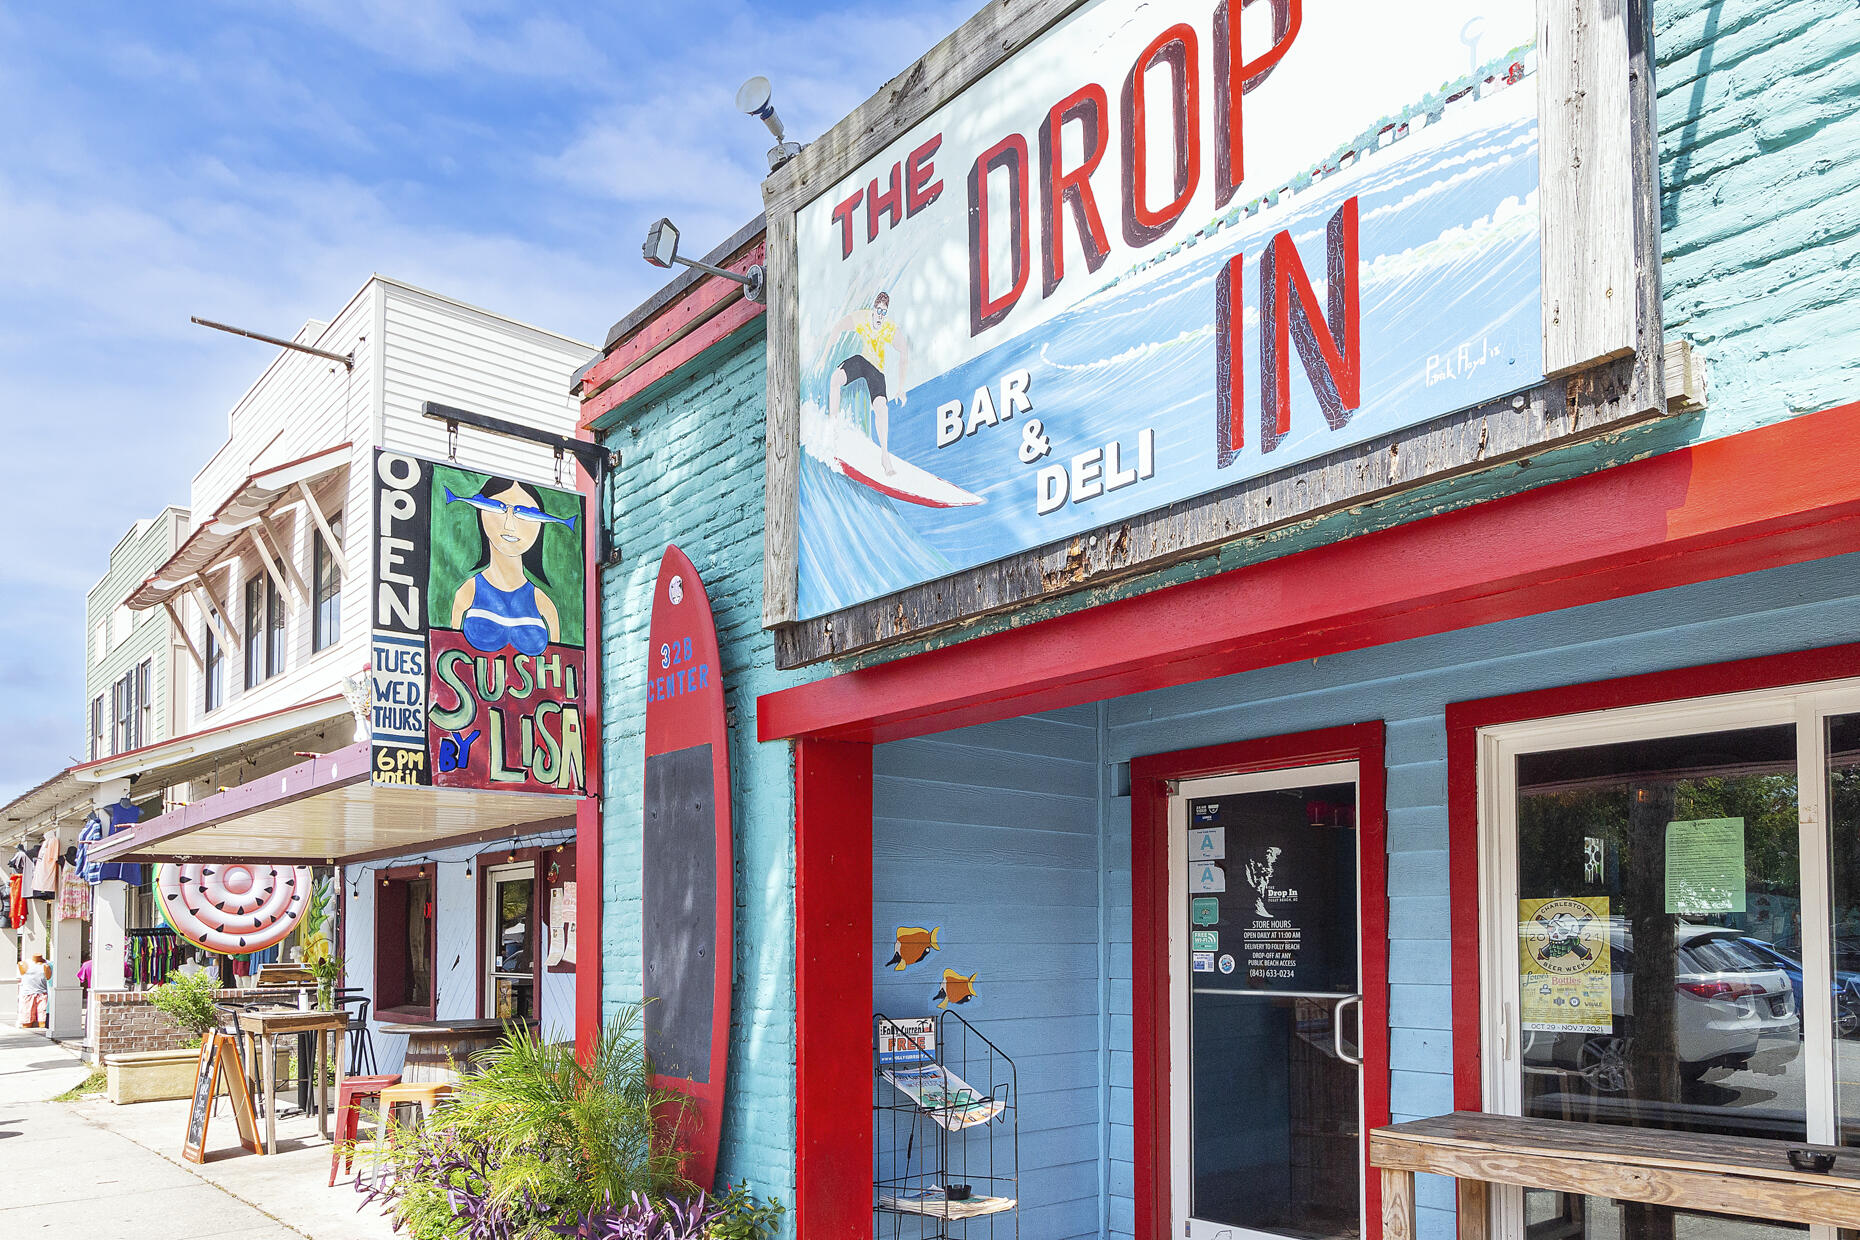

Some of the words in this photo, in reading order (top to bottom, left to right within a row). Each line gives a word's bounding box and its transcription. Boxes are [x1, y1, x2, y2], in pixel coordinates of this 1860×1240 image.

[831, 132, 944, 261] THE
[967, 0, 1302, 338] DROP
[1216, 195, 1360, 469] IN
[937, 368, 1033, 449] BAR
[1018, 418, 1052, 464] &
[1036, 428, 1154, 516] DELI
[377, 452, 421, 630] OPEN
[373, 647, 424, 675] TUES.
[660, 636, 693, 669] 32B
[372, 677, 423, 706] WED.
[428, 649, 579, 731] SUSHI
[646, 663, 709, 703] CENTER
[372, 705, 425, 732] THURS.
[439, 729, 481, 772] BY
[488, 700, 585, 790] LISA
[372, 769, 420, 785] until
[1200, 834, 1214, 850] A
[1200, 866, 1214, 882] A
[1268, 889, 1288, 898] Drop
[1288, 888, 1298, 896] In
[1540, 901, 1587, 914] CHARLESTON
[1243, 931, 1257, 939] OPEN
[1257, 931, 1270, 939] DAILY
[1271, 931, 1277, 939] AT
[1278, 931, 1292, 939] 11:00
[1292, 931, 1301, 939] AM
[1252, 920, 1270, 928] STORE
[1271, 920, 1292, 928] HOURS
[1529, 933, 1546, 942] 20
[1584, 932, 1600, 942] 21
[1249, 969, 1265, 978] (843)
[1265, 969, 1295, 978] 633-0234
[1279, 959, 1297, 967] ACCESS
[1542, 961, 1563, 972] BEER
[1565, 961, 1587, 972] WEEK
[888, 1036, 926, 1051] FREE
